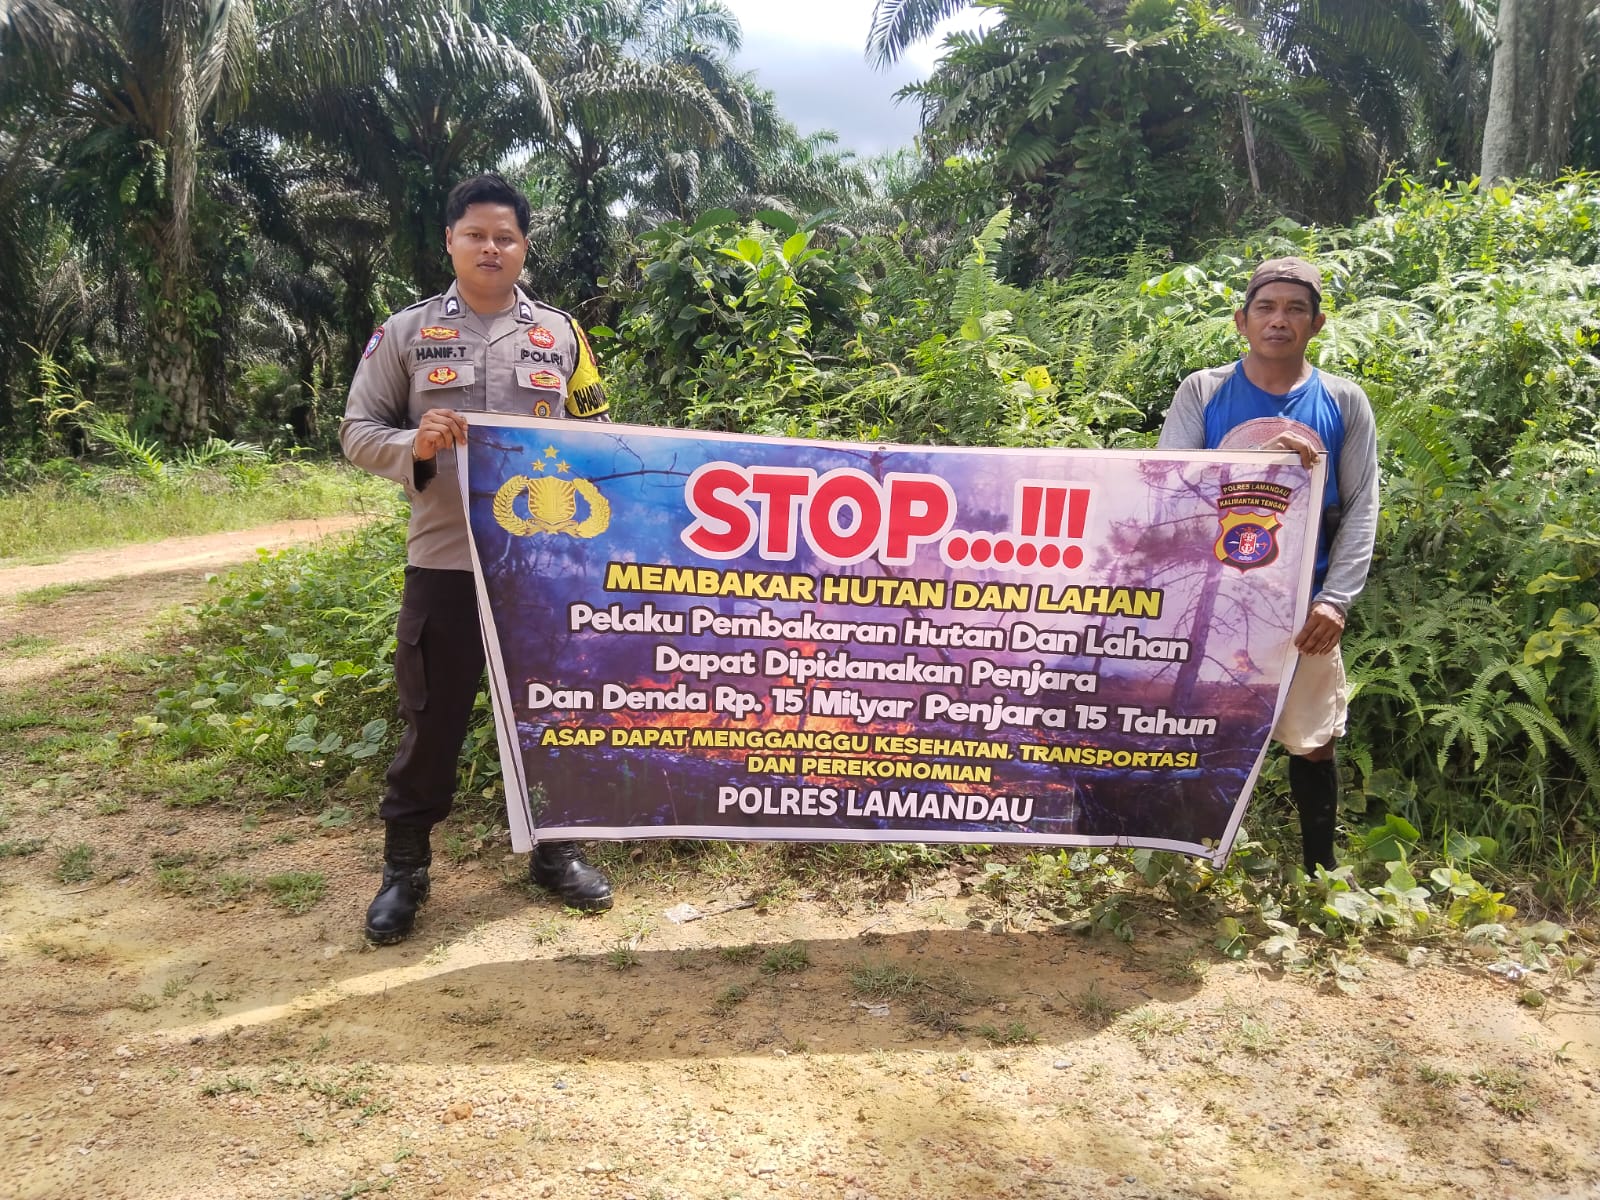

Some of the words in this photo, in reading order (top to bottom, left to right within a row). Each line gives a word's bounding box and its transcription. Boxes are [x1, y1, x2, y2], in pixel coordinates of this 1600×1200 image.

[520, 348, 563, 366] POLRI
[1220, 499, 1259, 508] KALIMANTAN
[1223, 484, 1249, 493] POLRES
[606, 564, 814, 601] MEMBAKAR
[823, 577, 945, 607] HUTAN
[953, 583, 1029, 611] DAN
[1037, 587, 1161, 617] LAHAN
[570, 603, 683, 633] Pelaku
[692, 609, 896, 644] Pembakaran
[904, 620, 1003, 649] Hutan
[1011, 624, 1077, 653] Dan
[1085, 628, 1189, 661] Lahan
[655, 646, 756, 680] Dapat
[765, 650, 963, 684] Dipidanakan
[972, 660, 1097, 696] Penjara
[528, 683, 594, 709] Dan
[602, 683, 707, 710] Denda
[715, 686, 763, 718] Rp.
[772, 688, 804, 713] 15
[812, 690, 913, 723] Milyar
[925, 694, 1066, 730] Penjara
[1075, 704, 1108, 730] 15
[1117, 707, 1217, 735] Tahun
[541, 729, 606, 746] ASAP
[611, 729, 687, 746] DAPAT
[692, 731, 869, 752] MENGGANGGU
[874, 736, 1014, 760] KESEHATAN,
[1019, 745, 1198, 767] TRANSPORTASI
[747, 756, 795, 774] DAN
[802, 758, 992, 782] PEREKONOMIAN
[718, 786, 838, 816] POLRES
[846, 789, 1034, 822] LAMANDAU
